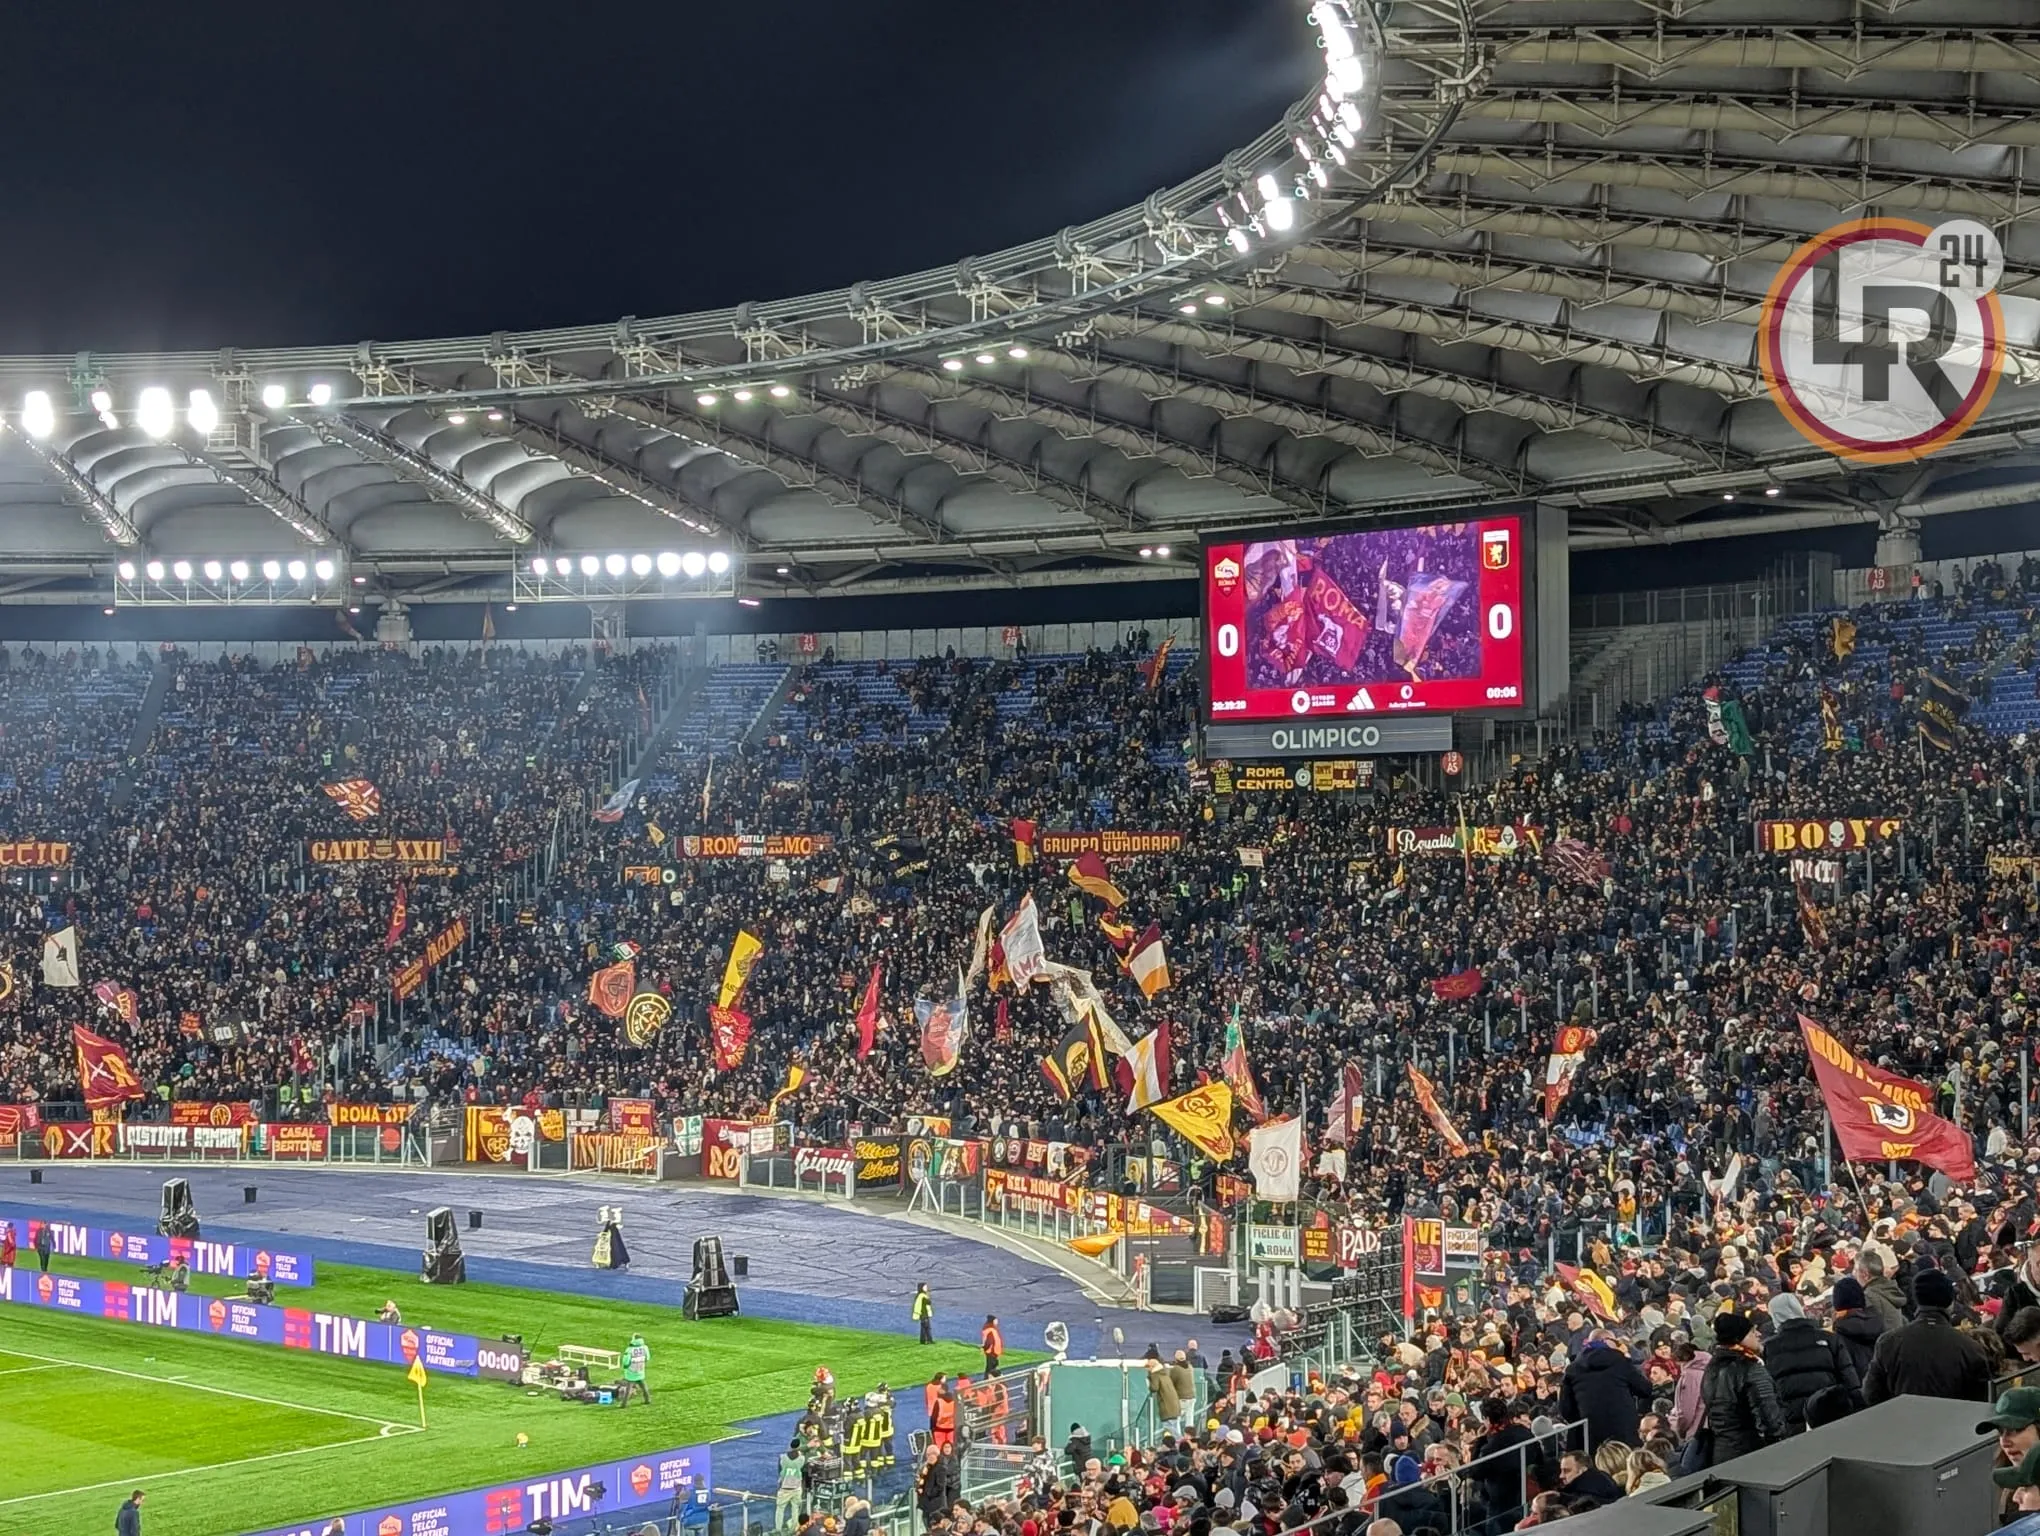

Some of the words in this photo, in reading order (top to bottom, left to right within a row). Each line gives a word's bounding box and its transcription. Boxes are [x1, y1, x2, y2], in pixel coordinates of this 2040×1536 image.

[1489, 603, 1513, 639] 0
[1218, 624, 1239, 657] 0
[1272, 726, 1380, 750] OLIMPICO
[1246, 767, 1285, 777] ROMA
[1236, 779, 1294, 790] CENTRO
[312, 840, 370, 861] GATE
[397, 841, 442, 861] XXII
[1043, 838, 1099, 853] GRUPPO
[340, 1106, 380, 1123] ROMA
[280, 1127, 316, 1139] CASAL
[274, 1139, 323, 1153] BERTONE
[50, 1223, 88, 1256] TIM
[1252, 1228, 1281, 1240] FIGLIE
[128, 1251, 149, 1260] PARTNER
[1266, 1244, 1294, 1256] ROMA
[193, 1240, 235, 1276] TIM
[275, 1254, 298, 1265] OFFICIAL
[275, 1263, 292, 1272] TELCO
[275, 1271, 299, 1281] PARTNER
[58, 1278, 81, 1290] OFFICIAL
[58, 1288, 74, 1298] TELCO
[58, 1296, 82, 1308] PARTNER
[131, 1286, 178, 1328] TIM
[231, 1304, 257, 1317] OFFICIAL
[231, 1314, 250, 1325] TELCO
[231, 1323, 258, 1336] PARTNER
[315, 1313, 366, 1358] TIM
[426, 1334, 455, 1347] OFFICIAL
[426, 1344, 446, 1356] TELCO
[426, 1354, 456, 1368] PARTNER
[477, 1349, 520, 1373] 00:00
[659, 1457, 692, 1472] OFFICIAL
[659, 1468, 683, 1481] TELCO
[526, 1473, 591, 1521] TIM
[411, 1506, 448, 1521] OFFICIAL
[411, 1519, 438, 1531] TELCO
